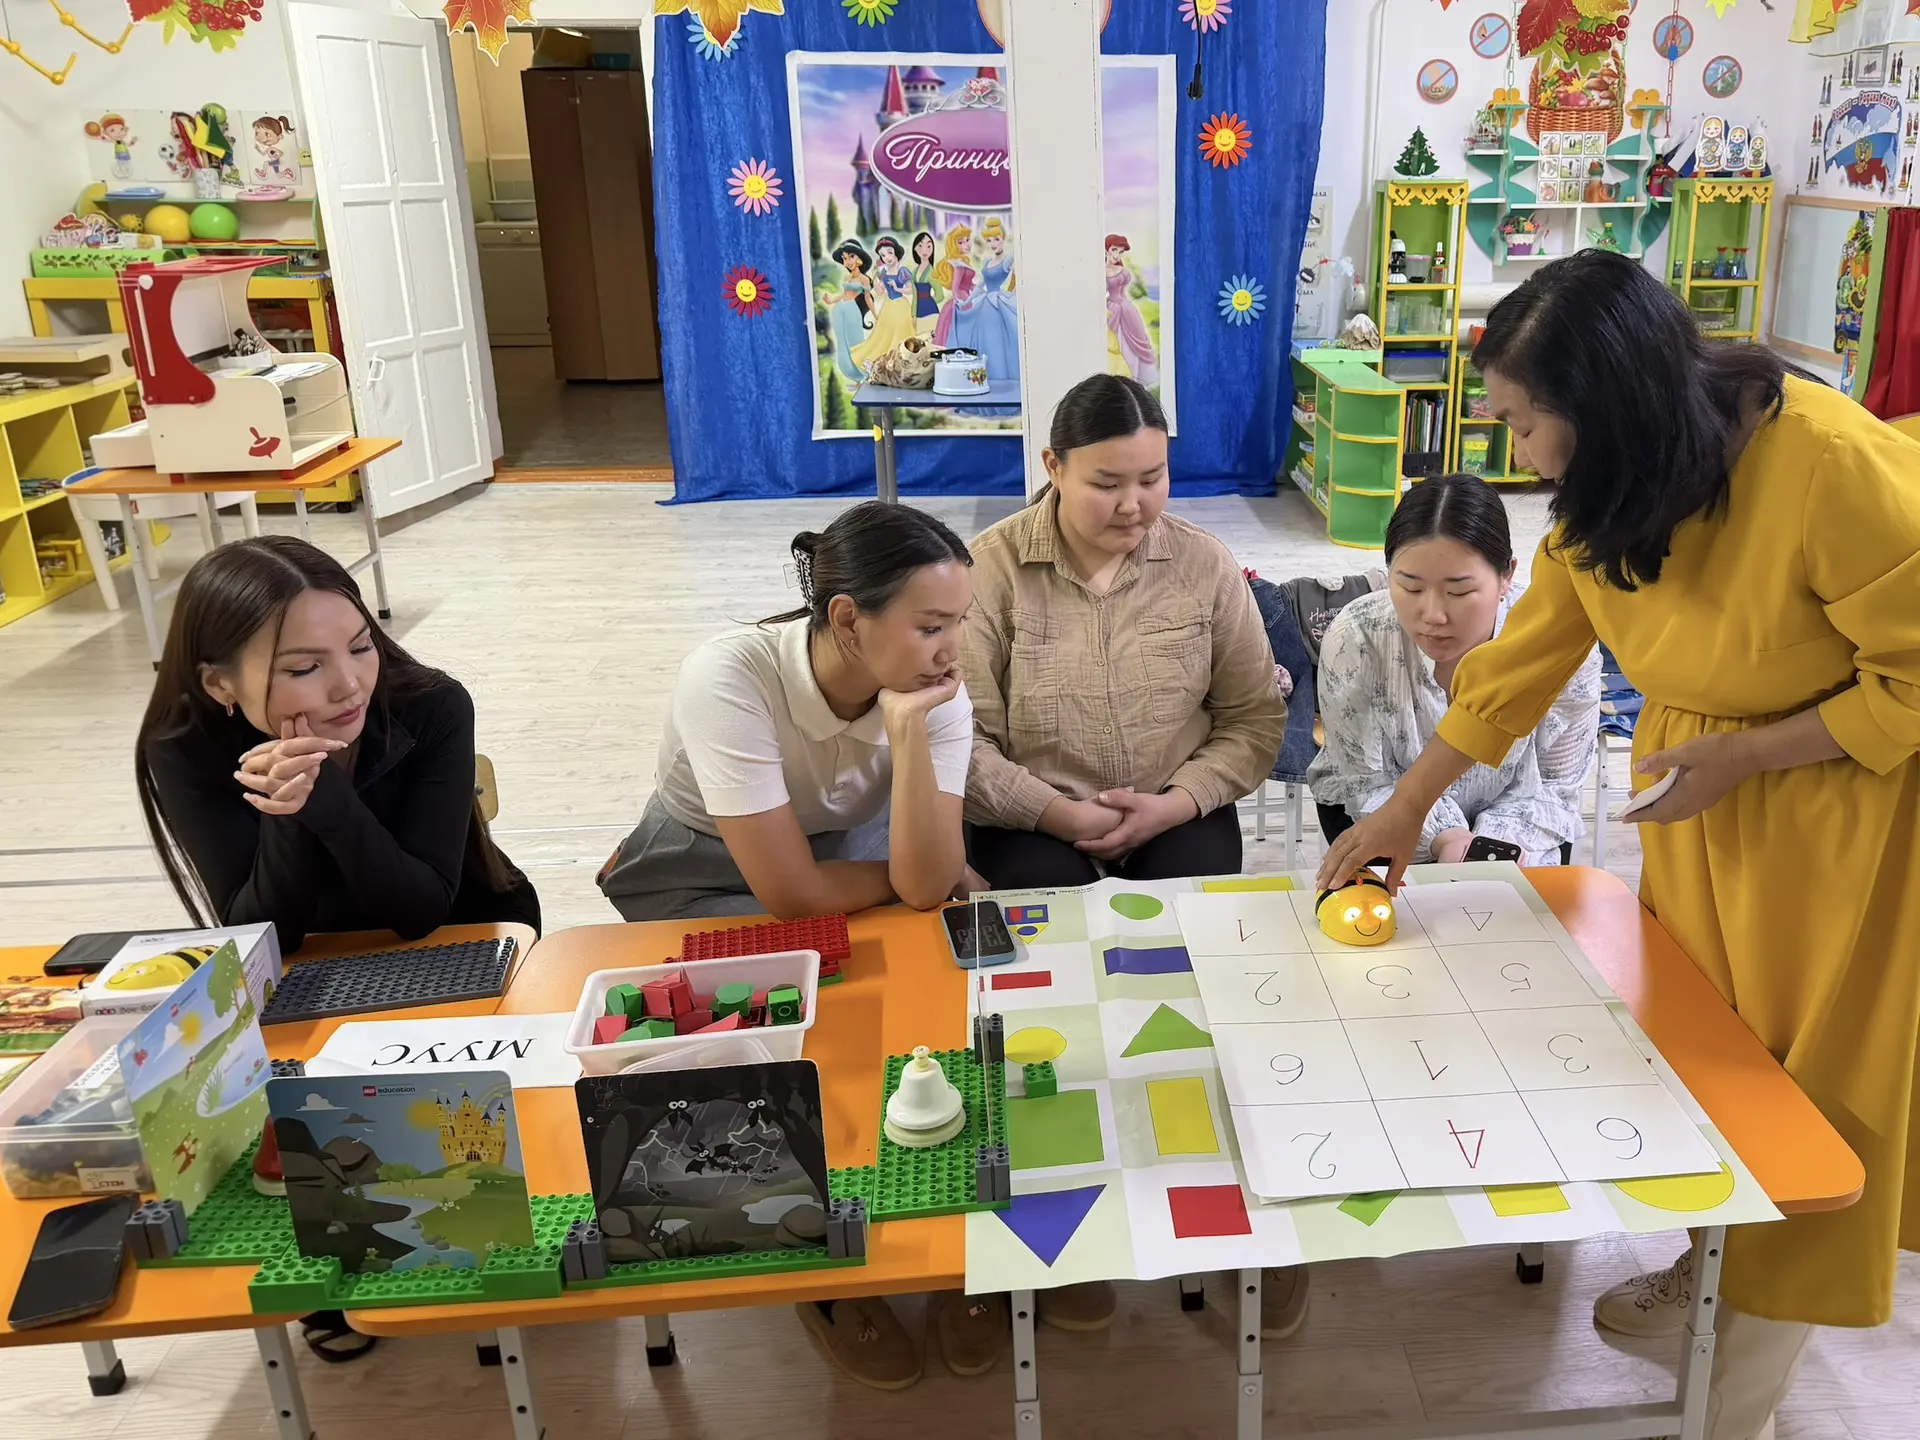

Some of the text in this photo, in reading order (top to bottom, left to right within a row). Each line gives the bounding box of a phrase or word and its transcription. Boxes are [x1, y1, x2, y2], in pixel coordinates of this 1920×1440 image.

[1237, 918, 1259, 942] 1
[1458, 905, 1494, 932] 4
[1244, 970, 1282, 1006] 2
[1366, 964, 1413, 1000] 3
[1500, 962, 1531, 992] 5
[371, 1038, 536, 1067] МУУС
[1269, 1053, 1304, 1085] 6
[1409, 1038, 1449, 1081] 1
[1547, 1034, 1590, 1074] 3
[378, 1086, 416, 1094] education
[1290, 1131, 1337, 1180] 2
[1447, 1119, 1486, 1169] 4
[1596, 1117, 1643, 1161] 6
